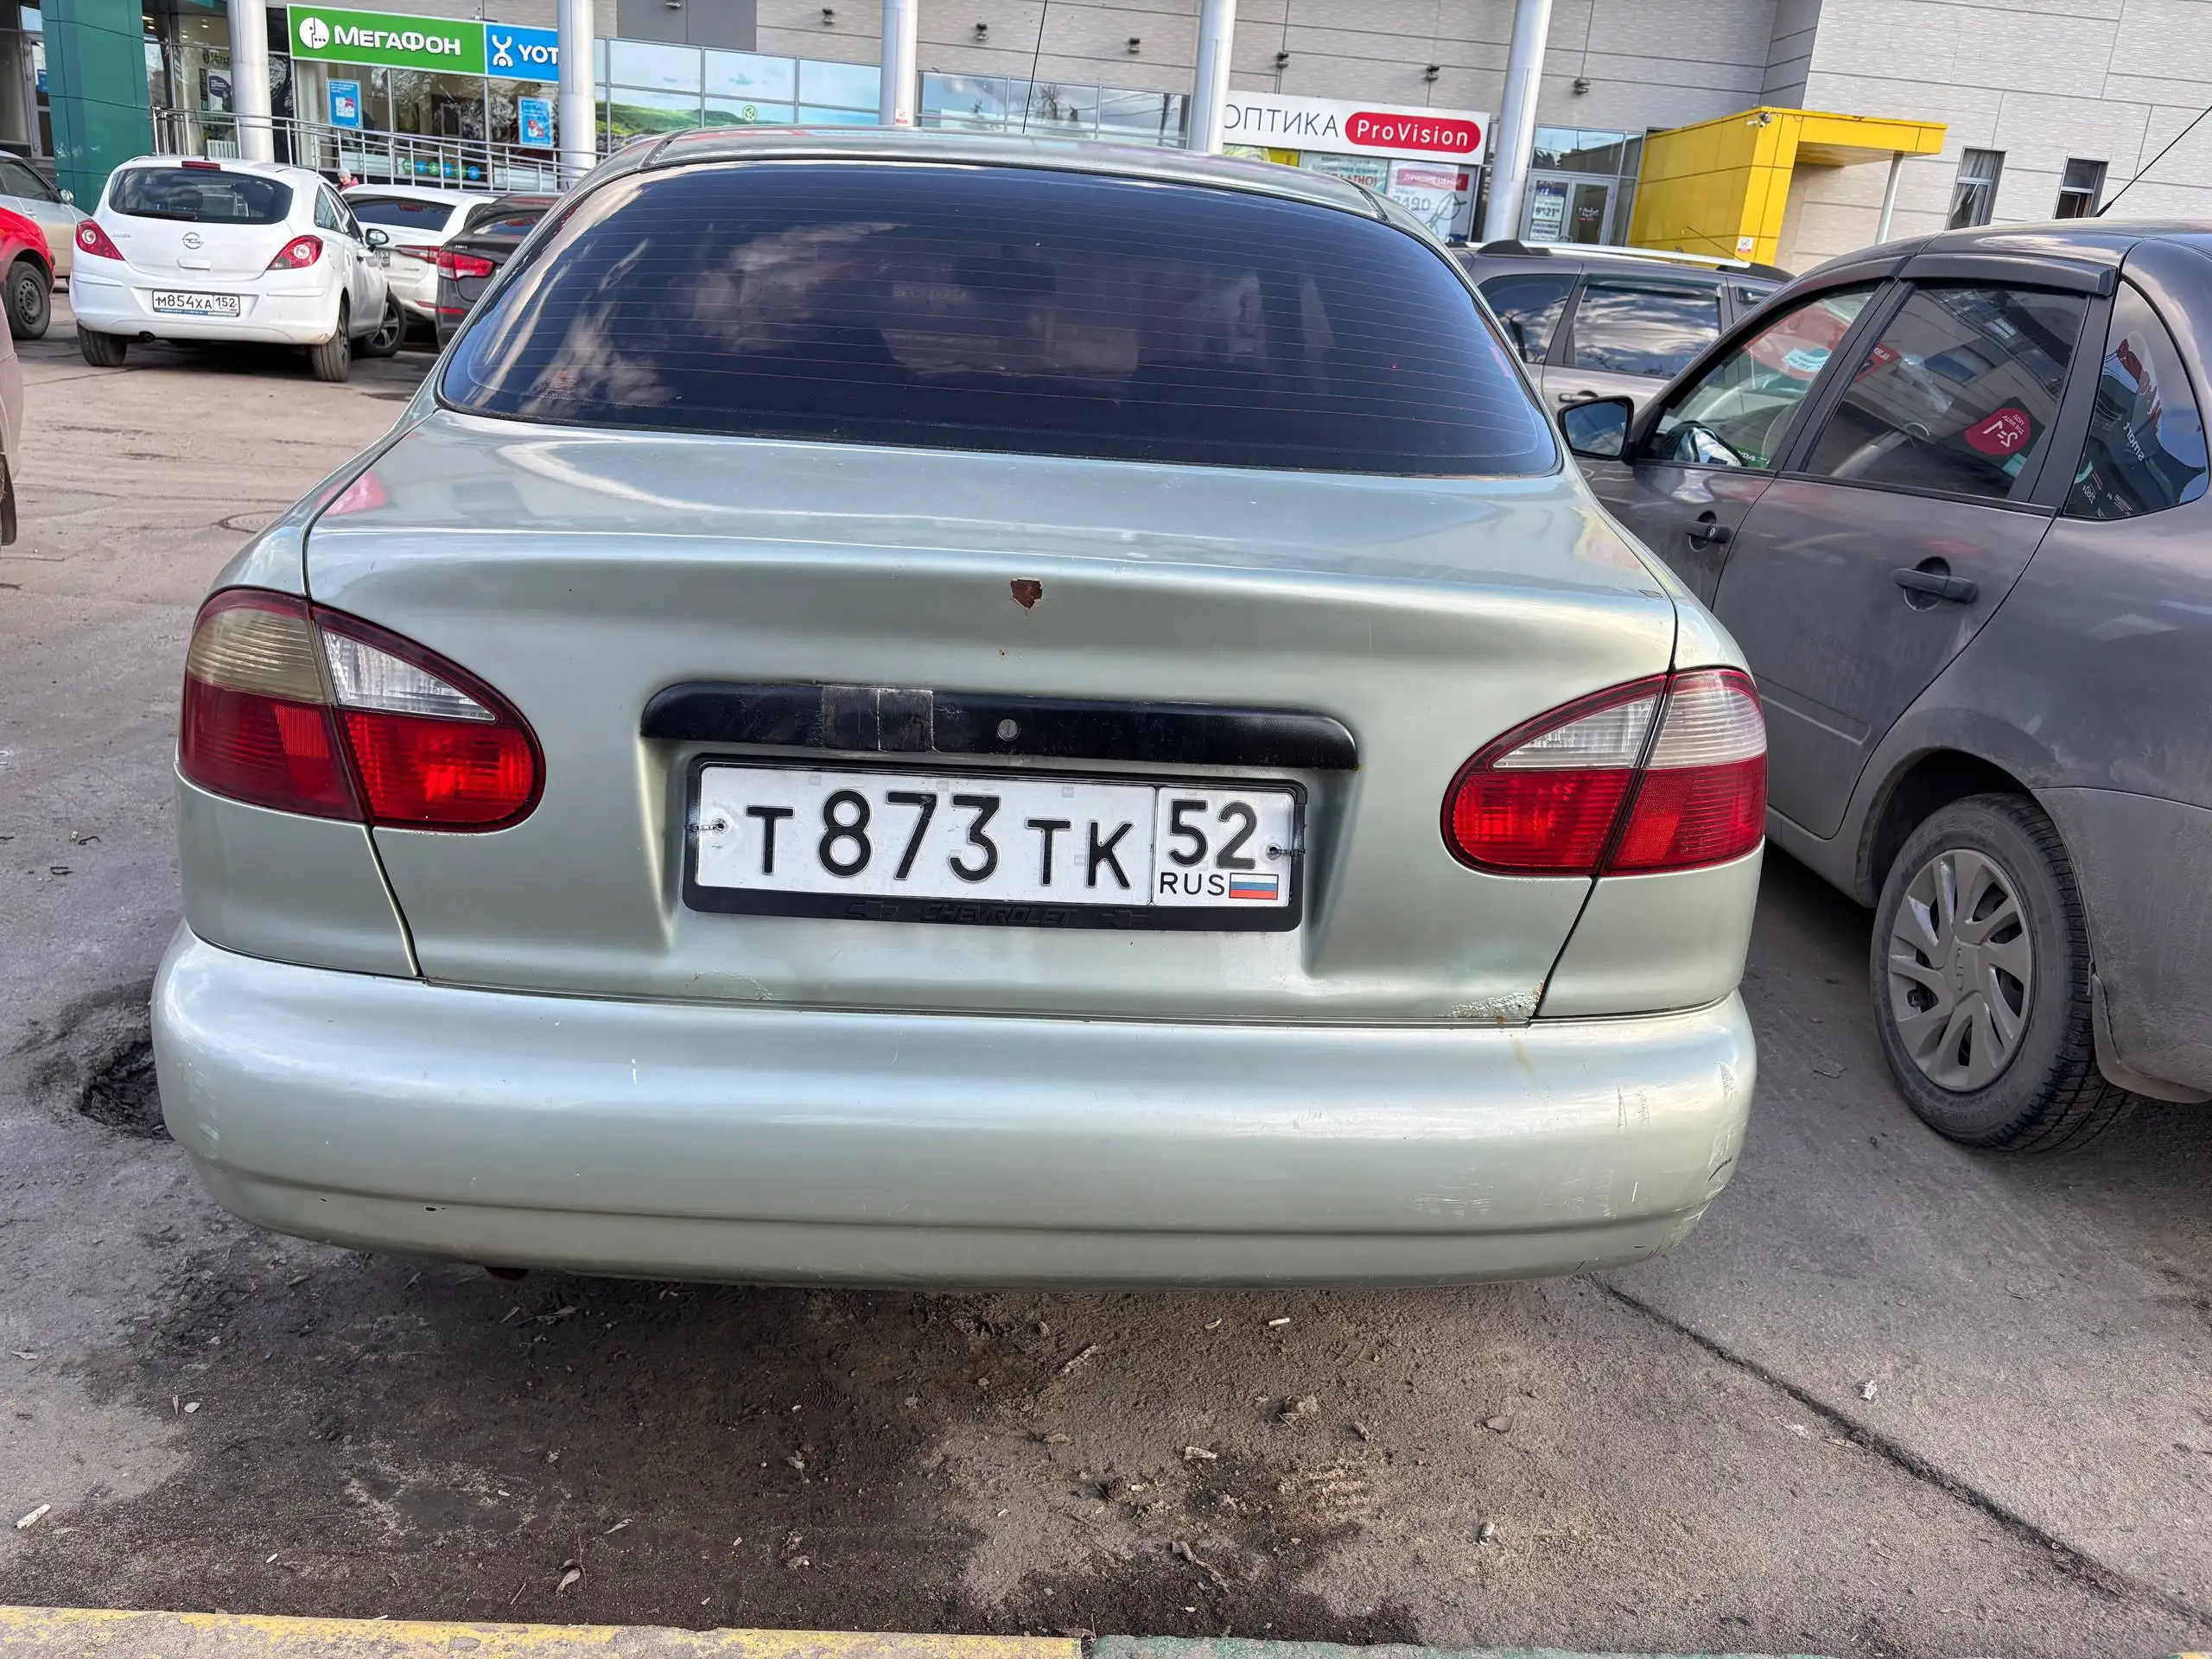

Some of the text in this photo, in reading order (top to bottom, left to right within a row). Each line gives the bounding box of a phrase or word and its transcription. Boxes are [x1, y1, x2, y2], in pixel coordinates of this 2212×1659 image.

[1224, 104, 1339, 138] ОПТИКА
[1357, 119, 1469, 147] ProVision
[215, 297, 236, 308] 152
[1167, 799, 1258, 872] 52
[1159, 871, 1226, 897] RUS
